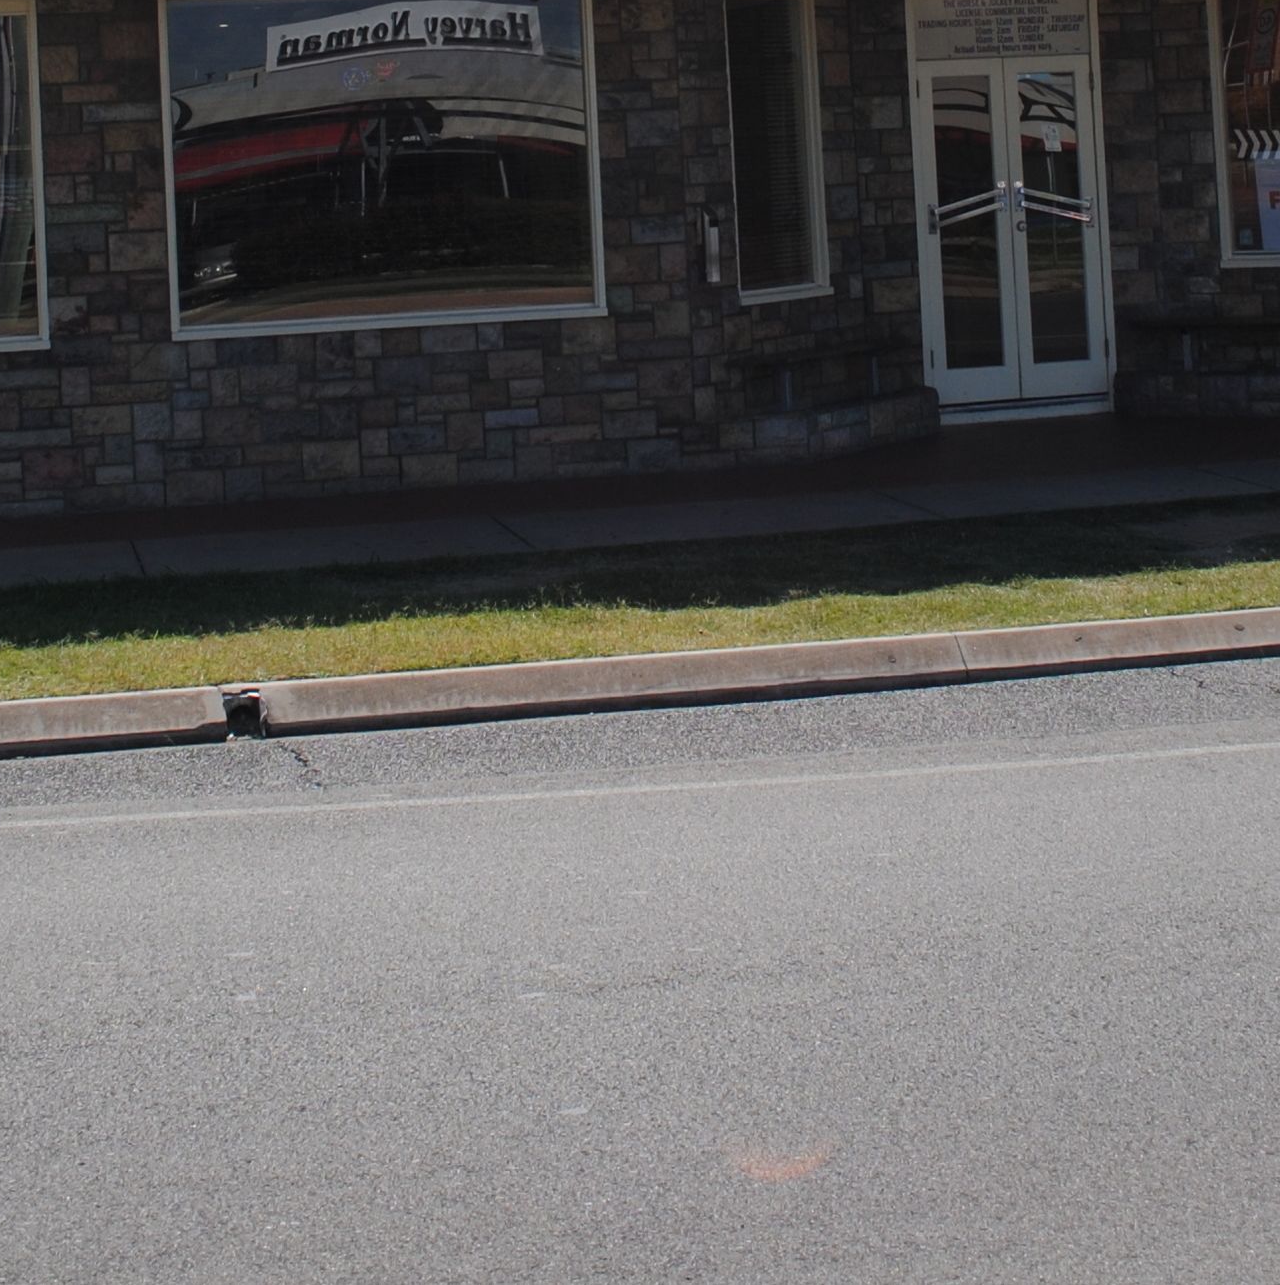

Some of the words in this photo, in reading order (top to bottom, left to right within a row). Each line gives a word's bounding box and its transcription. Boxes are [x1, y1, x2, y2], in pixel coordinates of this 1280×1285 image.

[943, 0, 956, 8] THE
[985, 7, 1025, 17] COMMERCIAL
[1027, 6, 1049, 15] HOTEL
[918, 19, 947, 29] TRADING
[1017, 16, 1044, 25] MONDAY
[1051, 14, 1086, 24] THURSDAY
[1018, 25, 1041, 34] FRIDAY
[1046, 23, 1080, 33] SATURDAY
[1018, 33, 1045, 43] SUNDAY
[954, 44, 976, 54] Actual
[976, 44, 1001, 55] trading
[1002, 43, 1021, 53] hours
[1022, 43, 1036, 53] may
